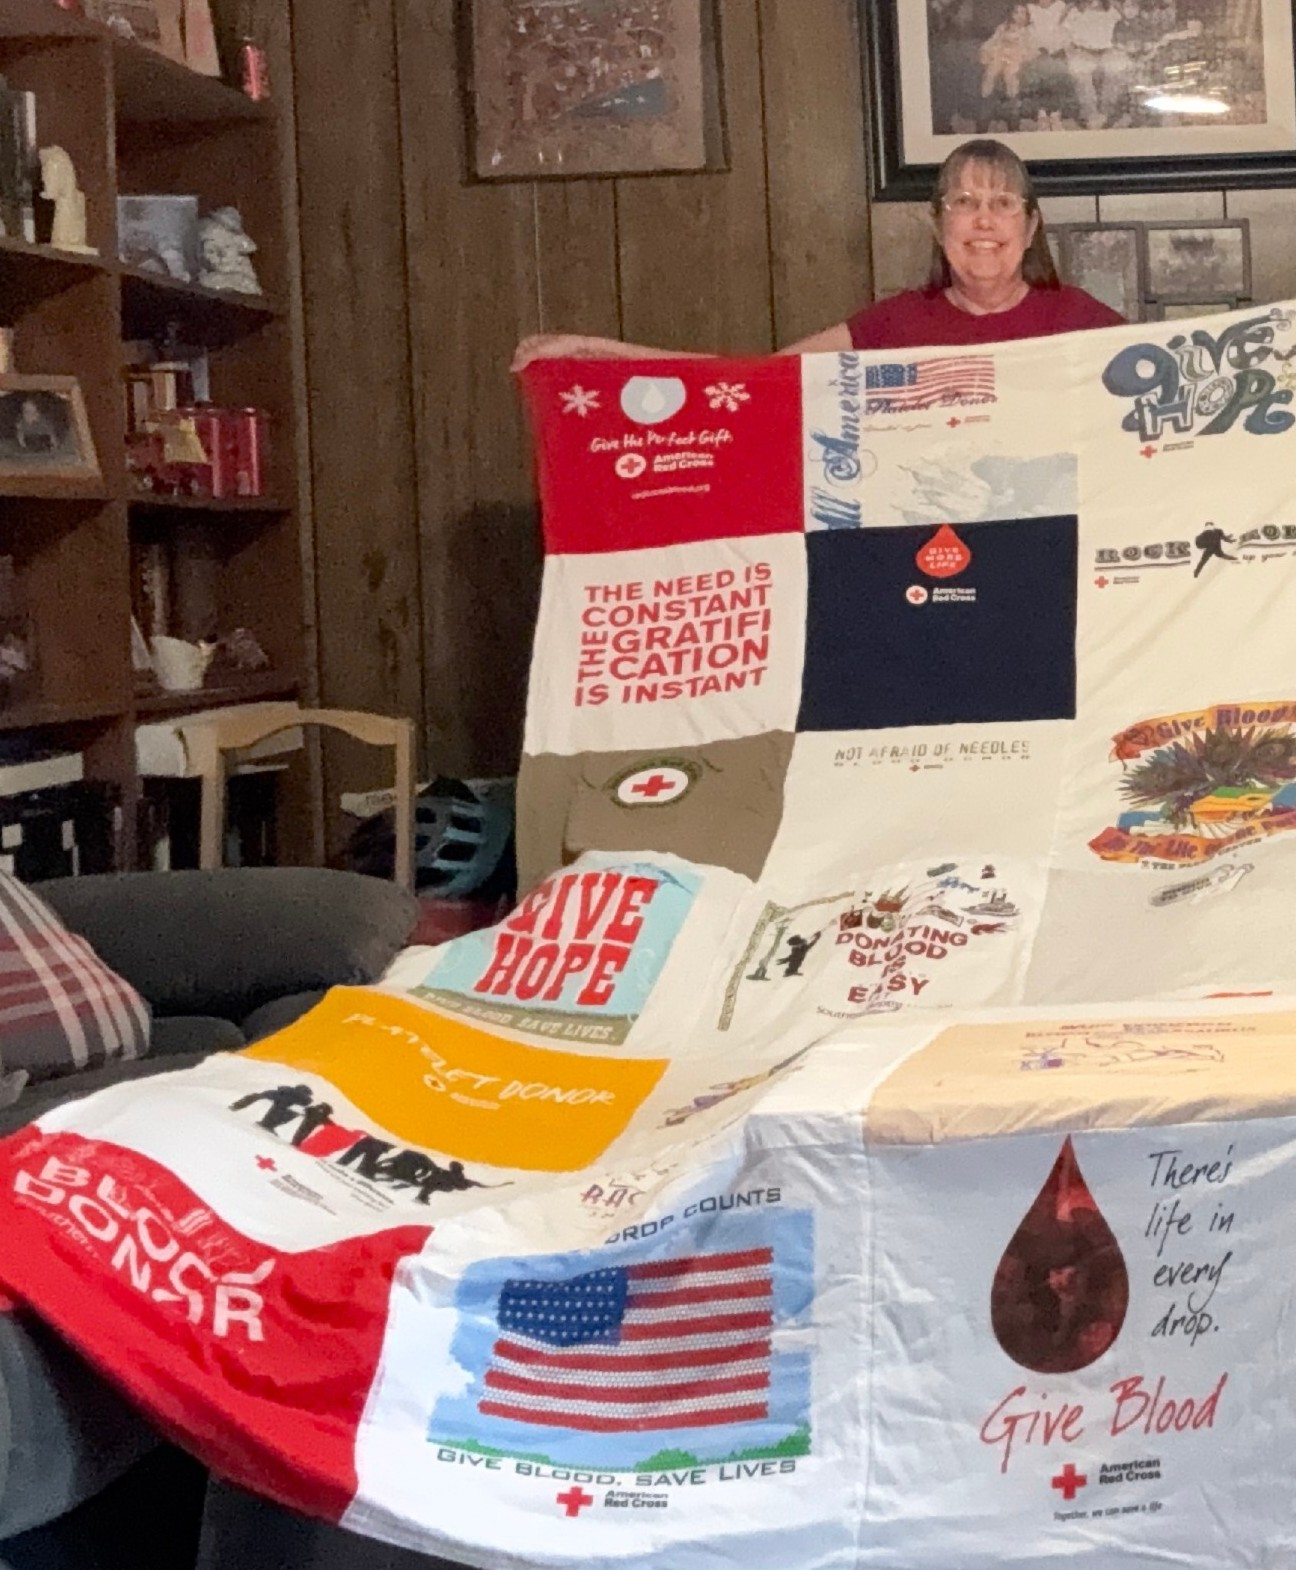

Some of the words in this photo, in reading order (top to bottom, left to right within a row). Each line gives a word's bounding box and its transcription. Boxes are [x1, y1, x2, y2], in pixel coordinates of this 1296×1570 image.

[591, 437, 620, 453] Give
[654, 453, 715, 464] American
[1095, 541, 1192, 563] ROCK
[584, 582, 643, 603] THE
[653, 569, 735, 598] NEED
[744, 562, 772, 583] IS
[581, 584, 772, 628] CONSTANT
[611, 608, 772, 654] GRATIFI
[578, 630, 608, 683] THE
[608, 634, 769, 680] CATION
[575, 684, 610, 707] IS
[621, 666, 768, 704] INSTANT
[1156, 714, 1207, 740] Give
[1216, 706, 1290, 726] Blood
[835, 746, 863, 761] NOT
[868, 743, 928, 759] AFRAID
[933, 742, 952, 757] OF
[959, 740, 1031, 755] NEEDLES
[473, 932, 632, 1006] HOPE
[498, 1080, 616, 1106] DONOR
[1148, 1145, 1235, 1188] There's
[604, 1215, 675, 1245] DROP
[683, 1187, 782, 1219] COUNTS
[1145, 1200, 1192, 1258] life
[1209, 1203, 1235, 1234] in
[1153, 1251, 1234, 1313] every
[1151, 1309, 1220, 1347] drop.
[979, 1386, 1085, 1474] Give
[1109, 1372, 1229, 1437] Blood
[436, 1448, 502, 1471] GIVE
[514, 1461, 623, 1487] BLOOD,
[634, 1469, 707, 1487] SAVE
[718, 1459, 797, 1482] LIVES
[1099, 1472, 1123, 1485] Red
[1125, 1470, 1162, 1482] Cross
[1100, 1459, 1161, 1474] American
[604, 1489, 669, 1500] American
[604, 1497, 632, 1509] Red
[633, 1497, 669, 1509] Cross
